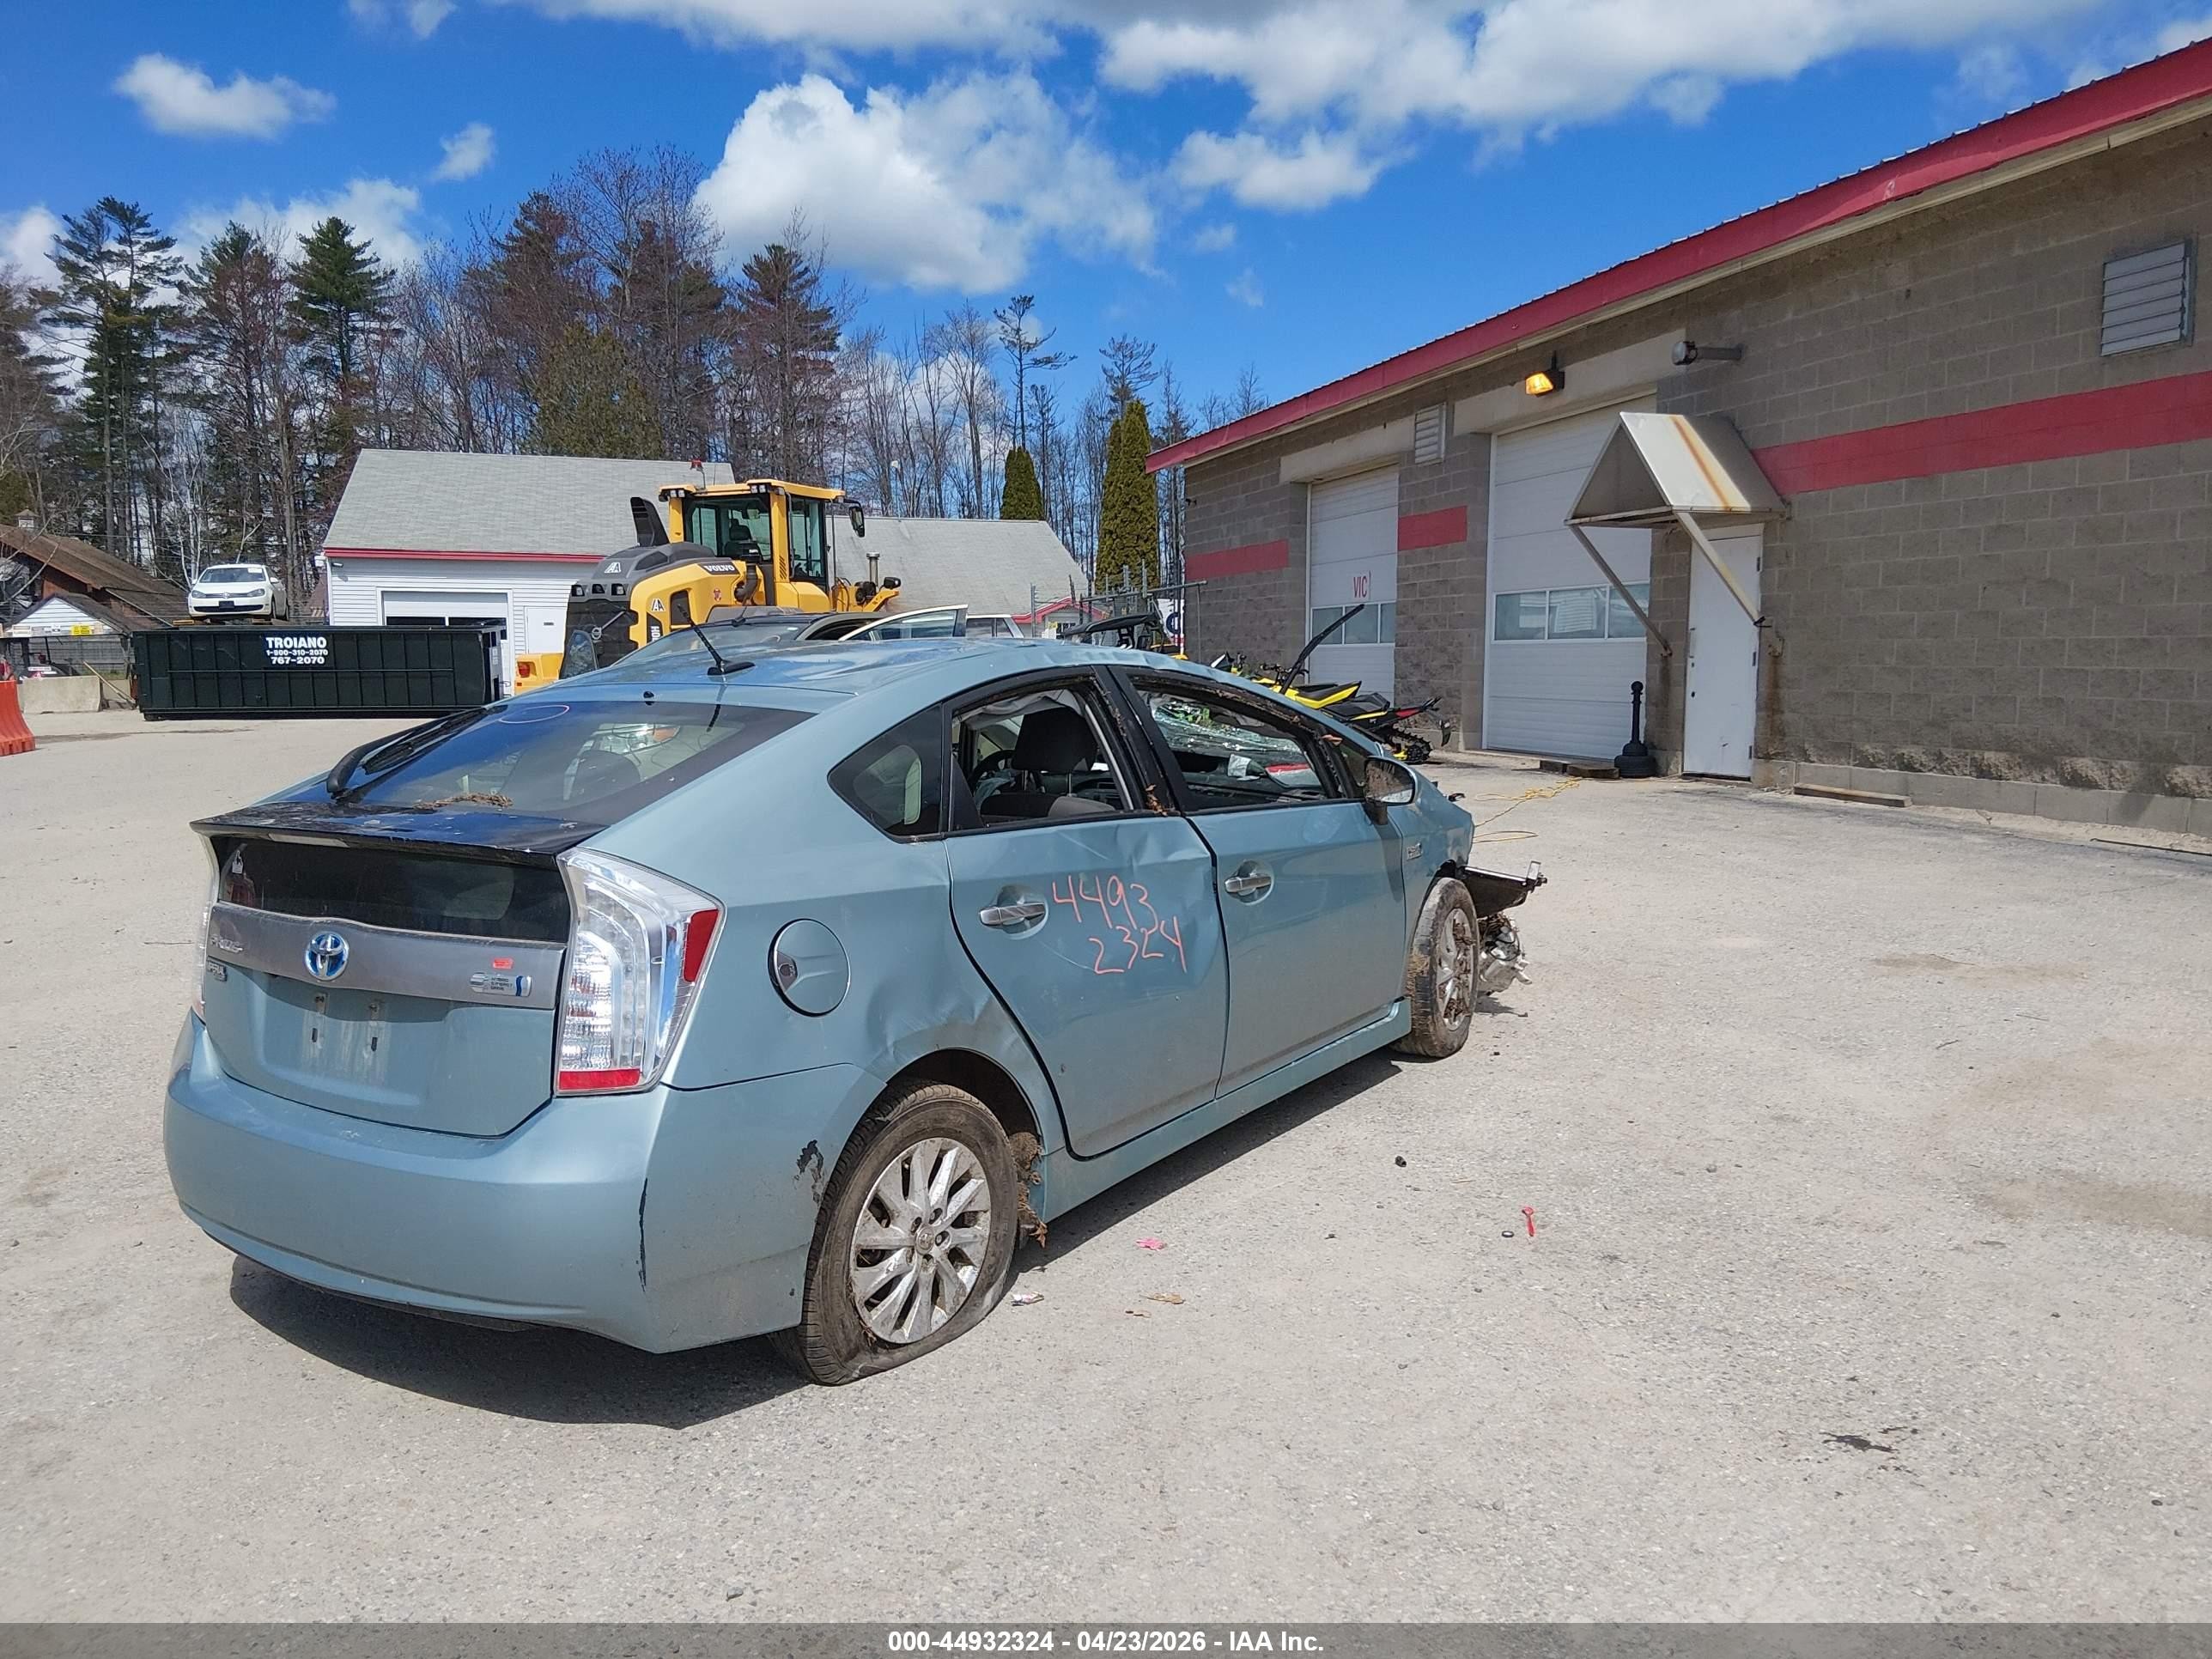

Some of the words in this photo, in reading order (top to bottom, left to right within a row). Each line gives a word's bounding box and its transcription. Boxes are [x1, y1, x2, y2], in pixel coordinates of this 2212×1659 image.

[265, 636, 327, 649] TROIANO
[1052, 874, 1159, 935] 4493
[1087, 915, 1188, 975] 2324
